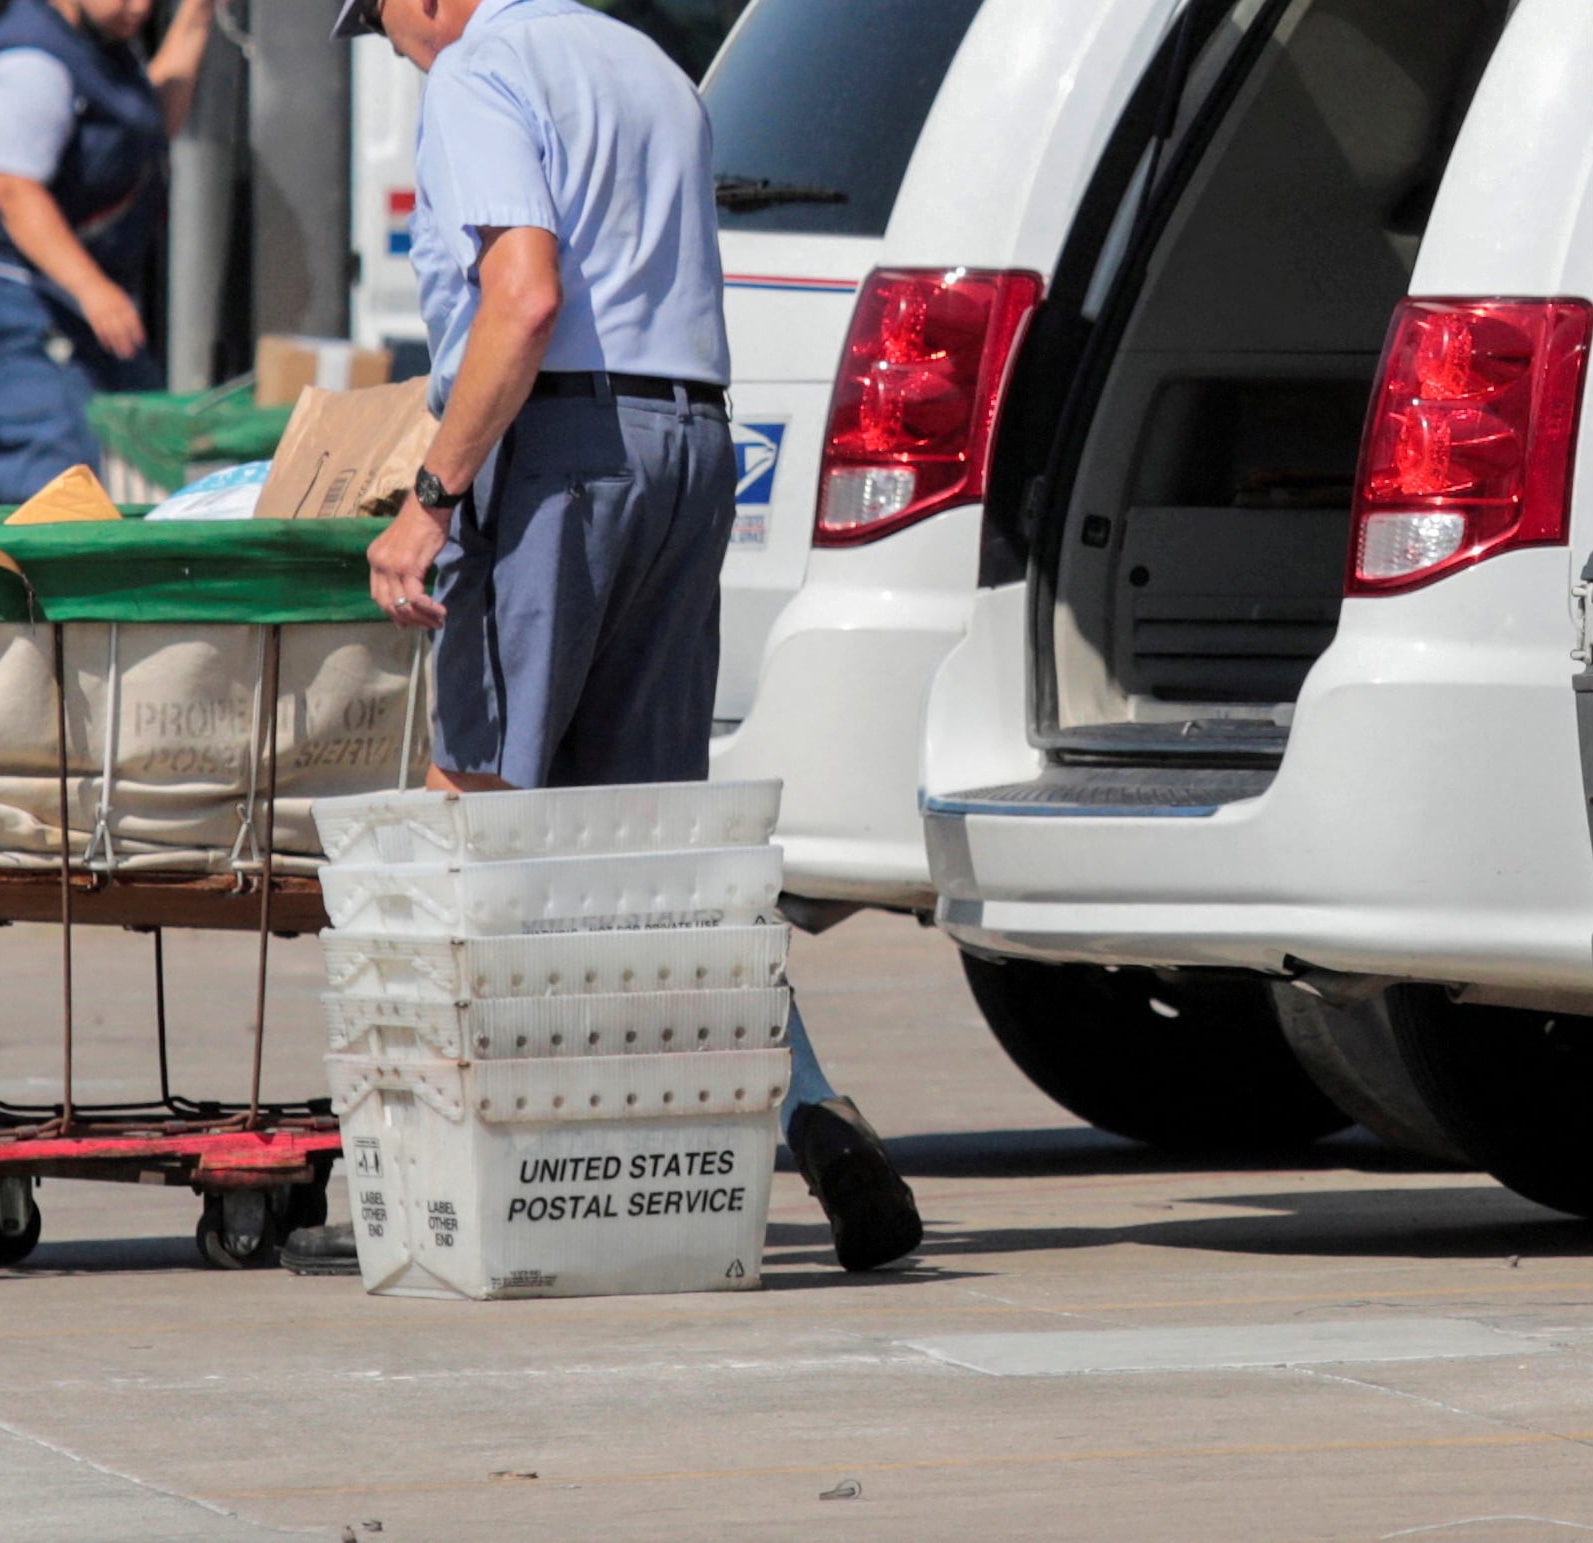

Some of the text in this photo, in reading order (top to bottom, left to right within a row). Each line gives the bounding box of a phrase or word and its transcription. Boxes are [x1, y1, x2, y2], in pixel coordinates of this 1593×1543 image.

[342, 695, 392, 732] OF
[520, 1150, 735, 1184] UNITED STATES
[360, 1190, 385, 1206] LABEL
[507, 1187, 745, 1222] POSTAL SERVICE
[361, 1207, 387, 1222] OTHER
[427, 1200, 457, 1215] LABEL
[367, 1223, 384, 1237] END
[428, 1215, 458, 1232] OTHER
[435, 1232, 454, 1248] END
